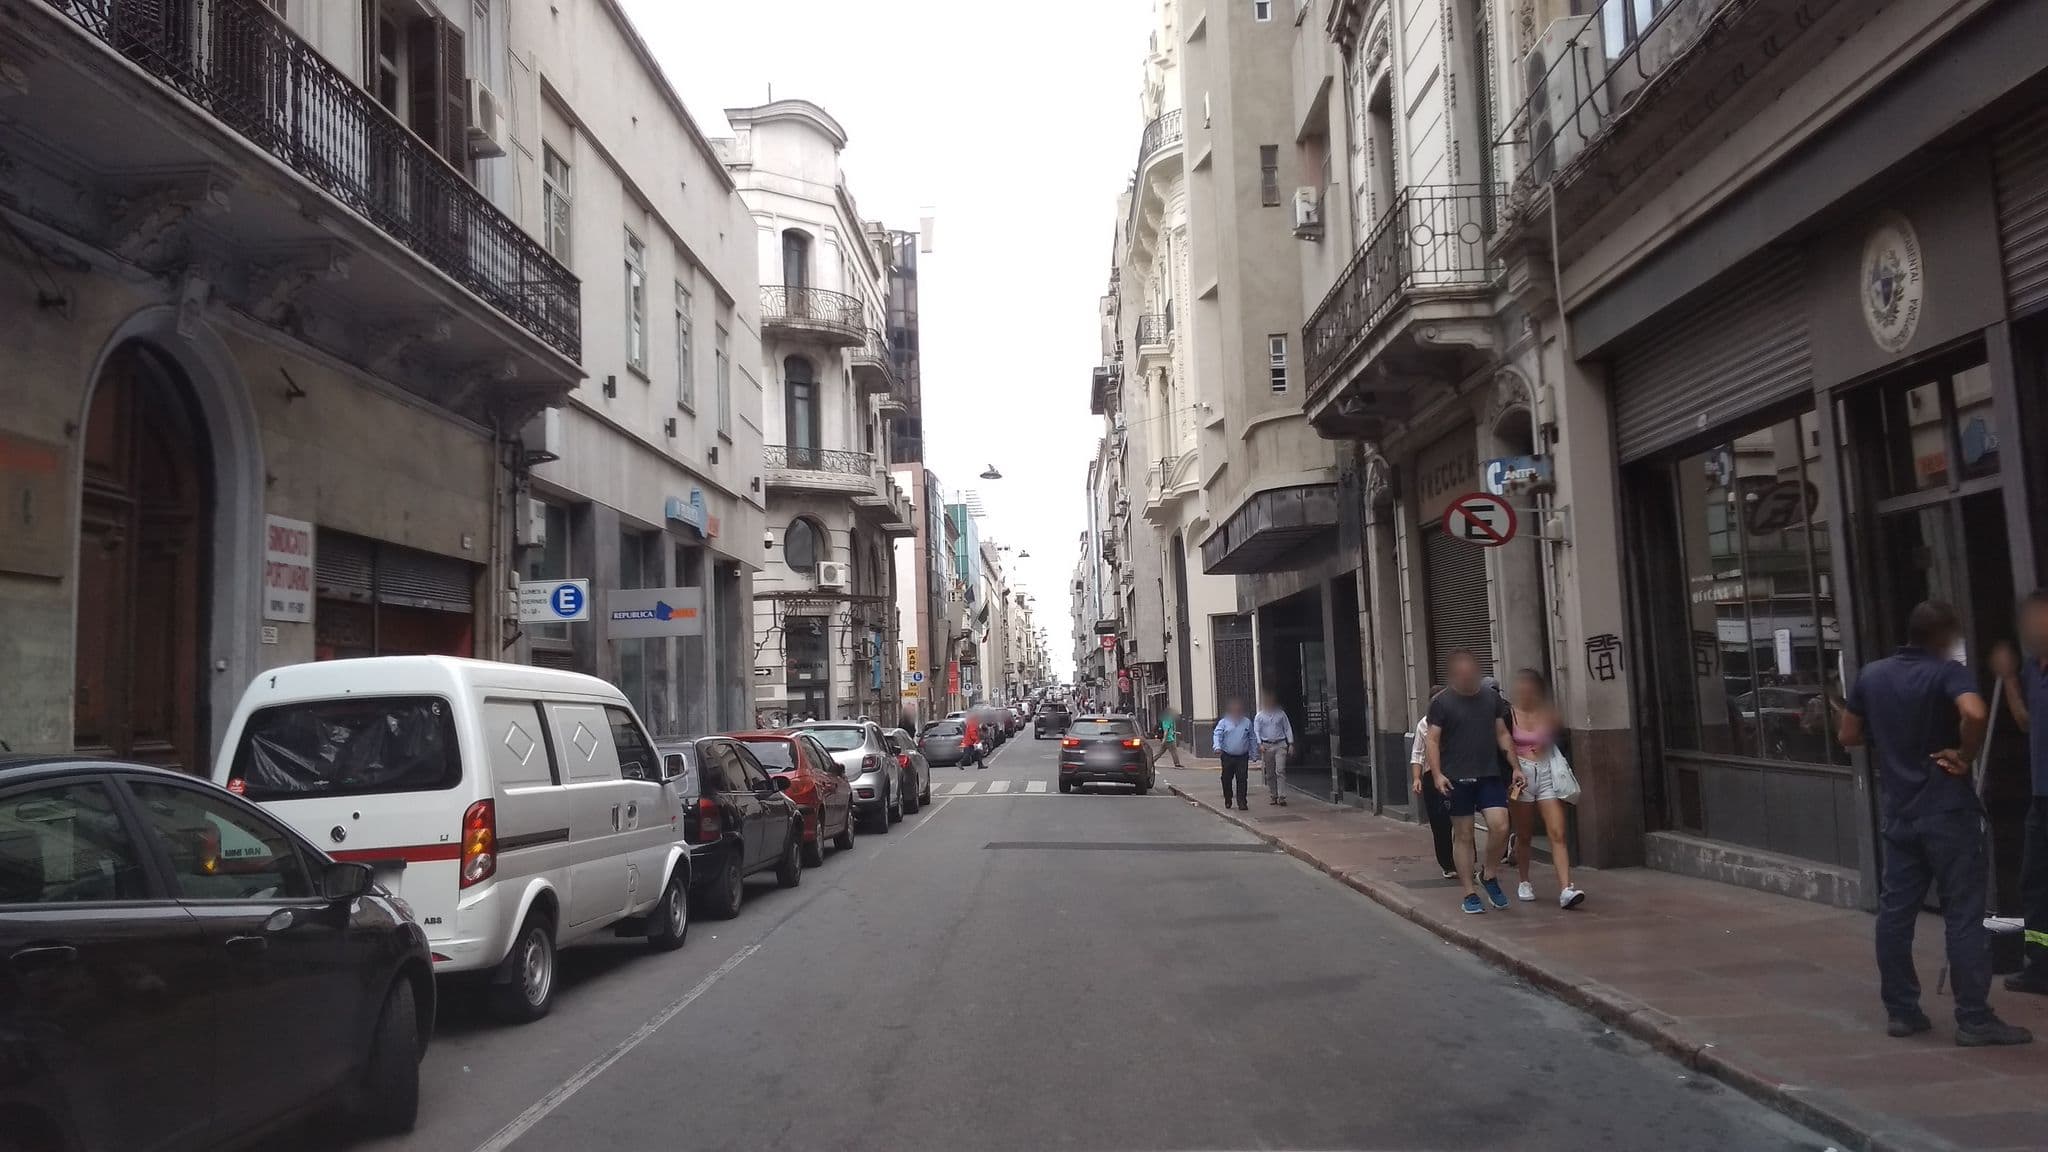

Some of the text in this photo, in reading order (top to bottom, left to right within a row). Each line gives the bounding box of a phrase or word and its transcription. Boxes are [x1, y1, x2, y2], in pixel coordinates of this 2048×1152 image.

[1464, 505, 1495, 540] E
[559, 588, 576, 609] E
[613, 611, 654, 619] REPUBLICA
[269, 676, 277, 689] 1
[224, 847, 261, 857] MINI VAN
[424, 917, 442, 926] ABS
